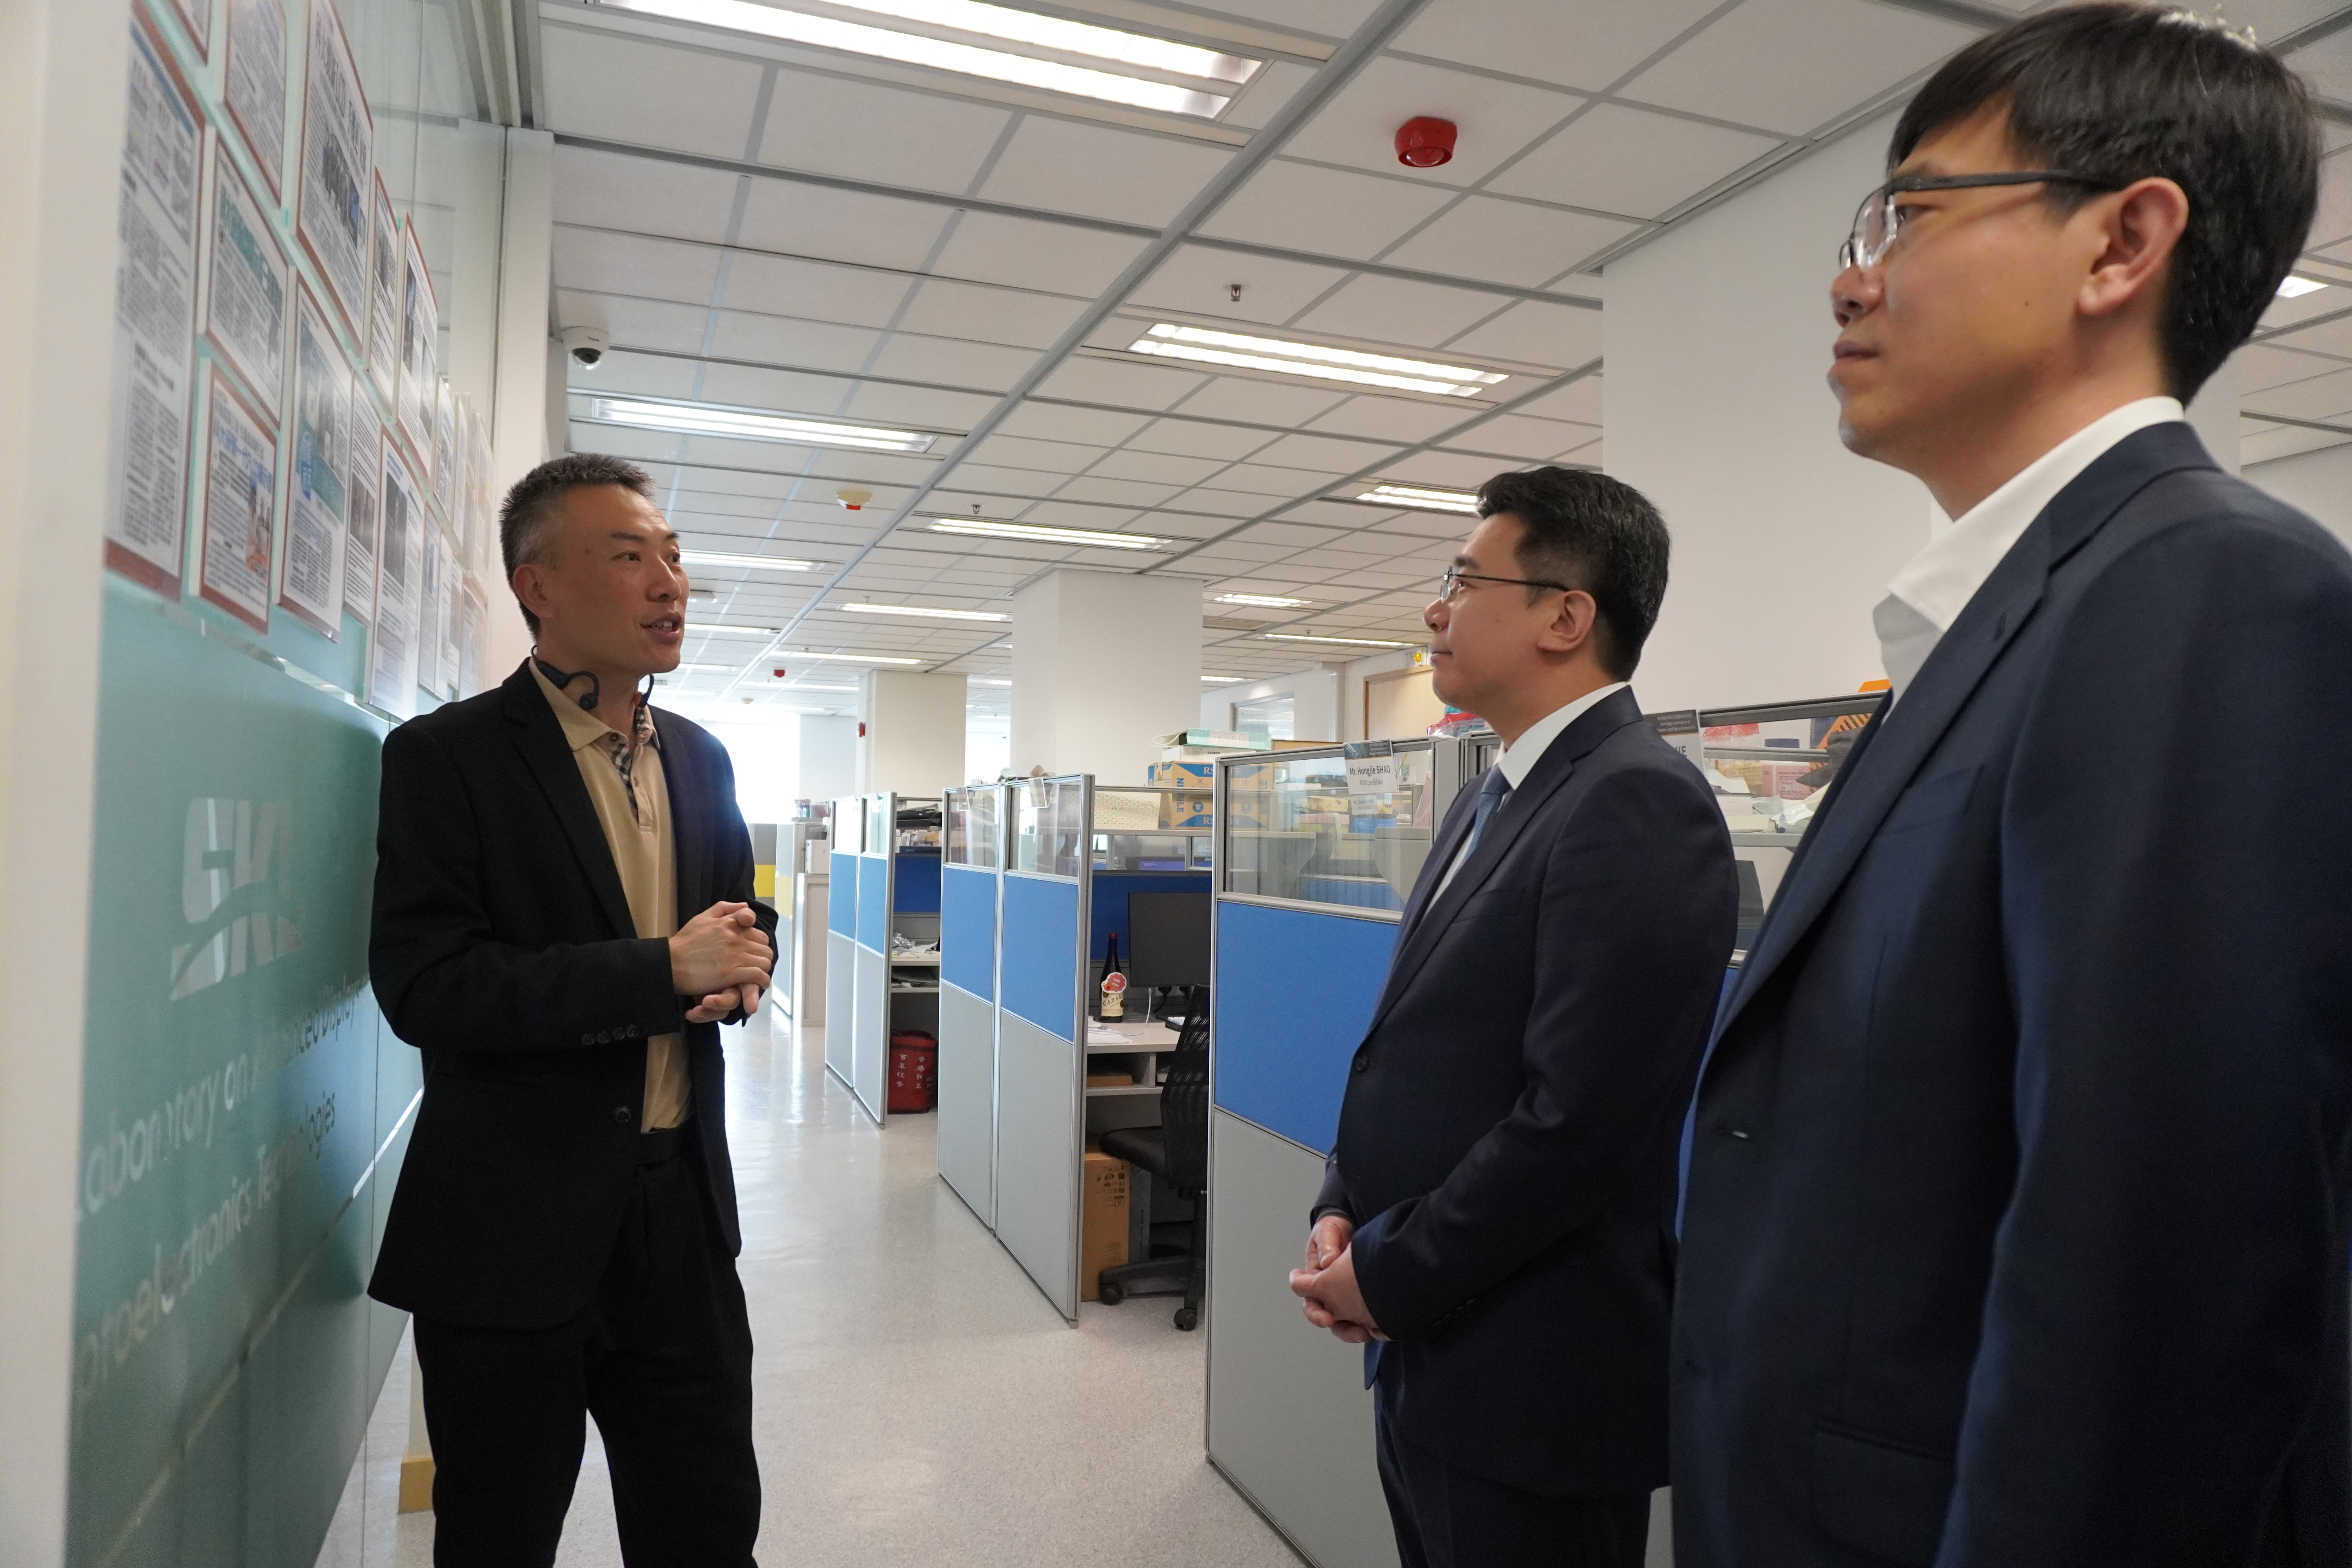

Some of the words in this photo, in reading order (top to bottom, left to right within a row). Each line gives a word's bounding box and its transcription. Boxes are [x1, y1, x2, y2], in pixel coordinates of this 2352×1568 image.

[1357, 766, 1376, 777] Hongjie
[1377, 765, 1390, 774] SHAO
[78, 1069, 221, 1221] aboratory
[223, 1052, 249, 1112] on
